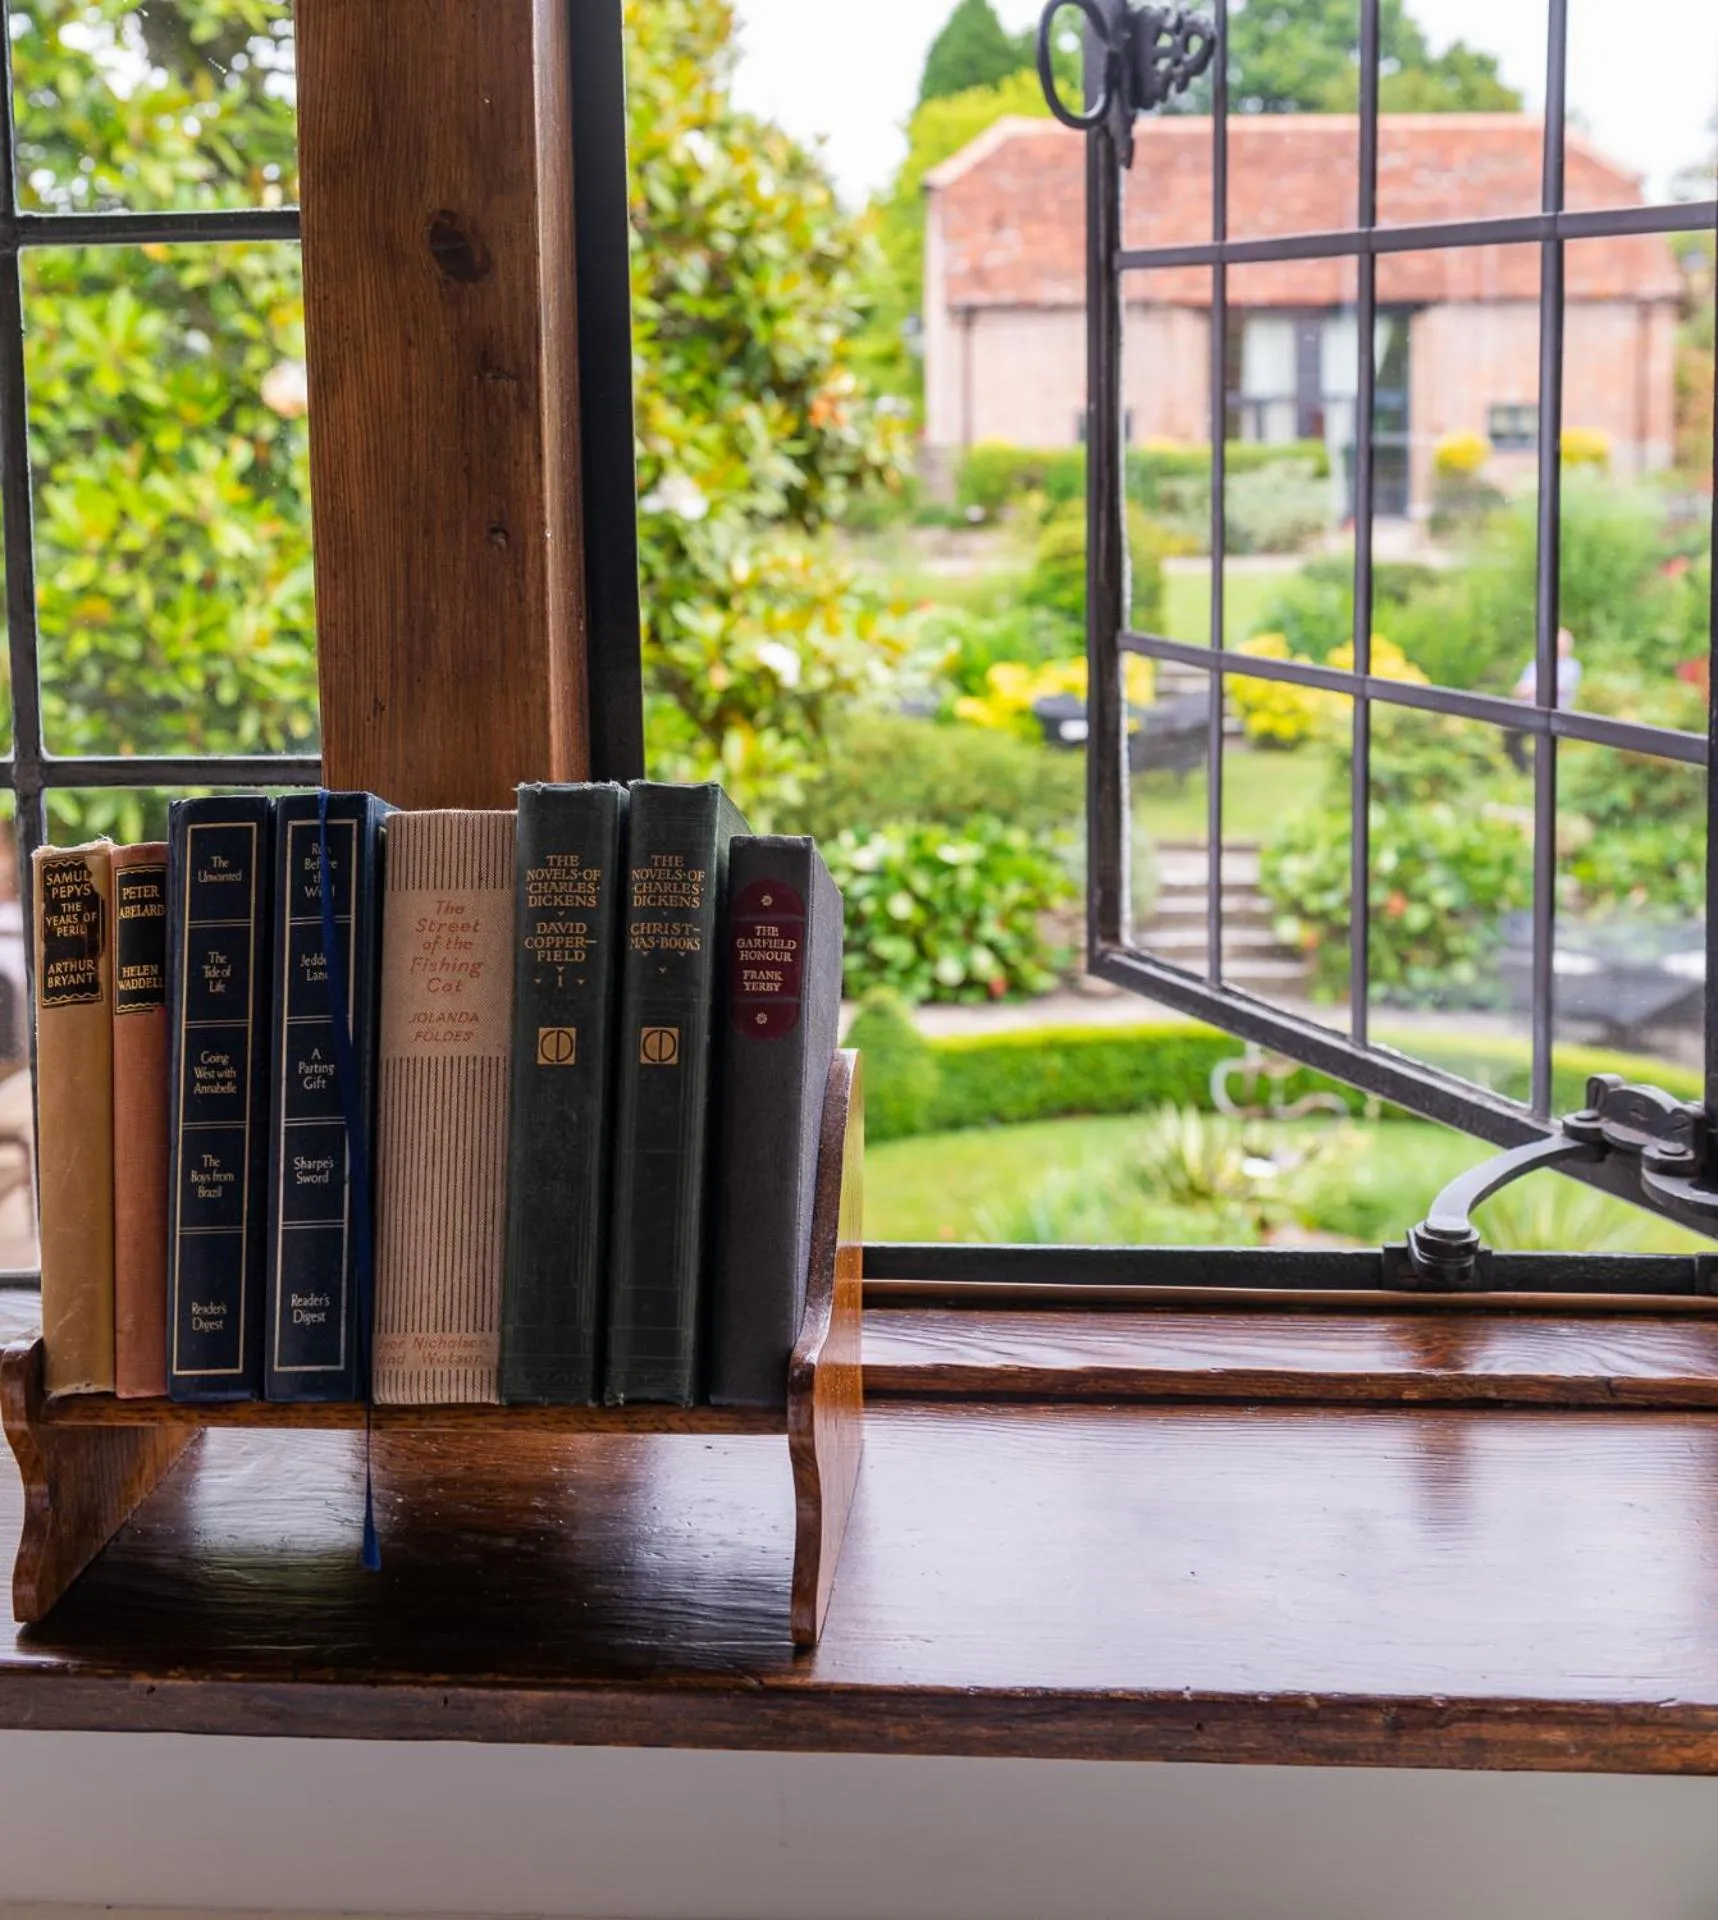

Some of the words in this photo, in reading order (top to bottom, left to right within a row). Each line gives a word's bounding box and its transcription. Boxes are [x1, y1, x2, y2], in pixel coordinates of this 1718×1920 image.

[211, 856, 229, 868] The
[547, 855, 580, 867] THE
[651, 855, 684, 867] THE
[198, 870, 242, 883] Unwanted
[51, 885, 92, 900] PEPYS
[122, 886, 160, 900] PETER
[61, 903, 82, 912] THE
[436, 900, 465, 915] The
[528, 895, 597, 908] DICKENS
[633, 895, 701, 908] DICKENS
[118, 904, 165, 921] ABELARD
[46, 914, 79, 927] YEARS
[83, 912, 97, 923] OF
[415, 917, 480, 933] Street
[56, 925, 87, 937] PERIL
[536, 922, 588, 934] DAVID
[754, 925, 779, 936] THE
[422, 935, 441, 955] of
[445, 936, 474, 950] the
[736, 938, 797, 950] GARFIELD
[208, 952, 227, 964] The
[537, 950, 586, 962] FIELD
[739, 950, 793, 962] HONOUR
[48, 960, 95, 975] ARTHUR
[122, 965, 159, 978] HELEN
[202, 966, 221, 978] Tide
[221, 965, 231, 977] of
[410, 957, 484, 978] Fishing
[47, 973, 94, 988] BRYANT
[742, 969, 783, 981] FRANK
[117, 977, 166, 991] WADDELL
[209, 982, 226, 993] Life
[427, 977, 463, 993] Cat
[743, 981, 782, 992] YERBY
[408, 1011, 479, 1024] JOLANDA
[200, 1051, 230, 1065] Going
[311, 1048, 322, 1060] A
[194, 1067, 216, 1080] West
[217, 1067, 237, 1078] with
[298, 1062, 335, 1076] Parting
[193, 1083, 238, 1095] Annabelle
[303, 1076, 327, 1090] Gift
[202, 1155, 221, 1168] The
[293, 1156, 334, 1170] Sharpe's
[191, 1170, 211, 1183] Boys
[212, 1170, 235, 1182] from
[296, 1171, 329, 1184] Sword
[197, 1185, 222, 1198] Brazil
[291, 1293, 330, 1308] Reader's
[191, 1302, 228, 1316] Reader's
[293, 1309, 326, 1325] Digest
[192, 1317, 224, 1332] Digest
